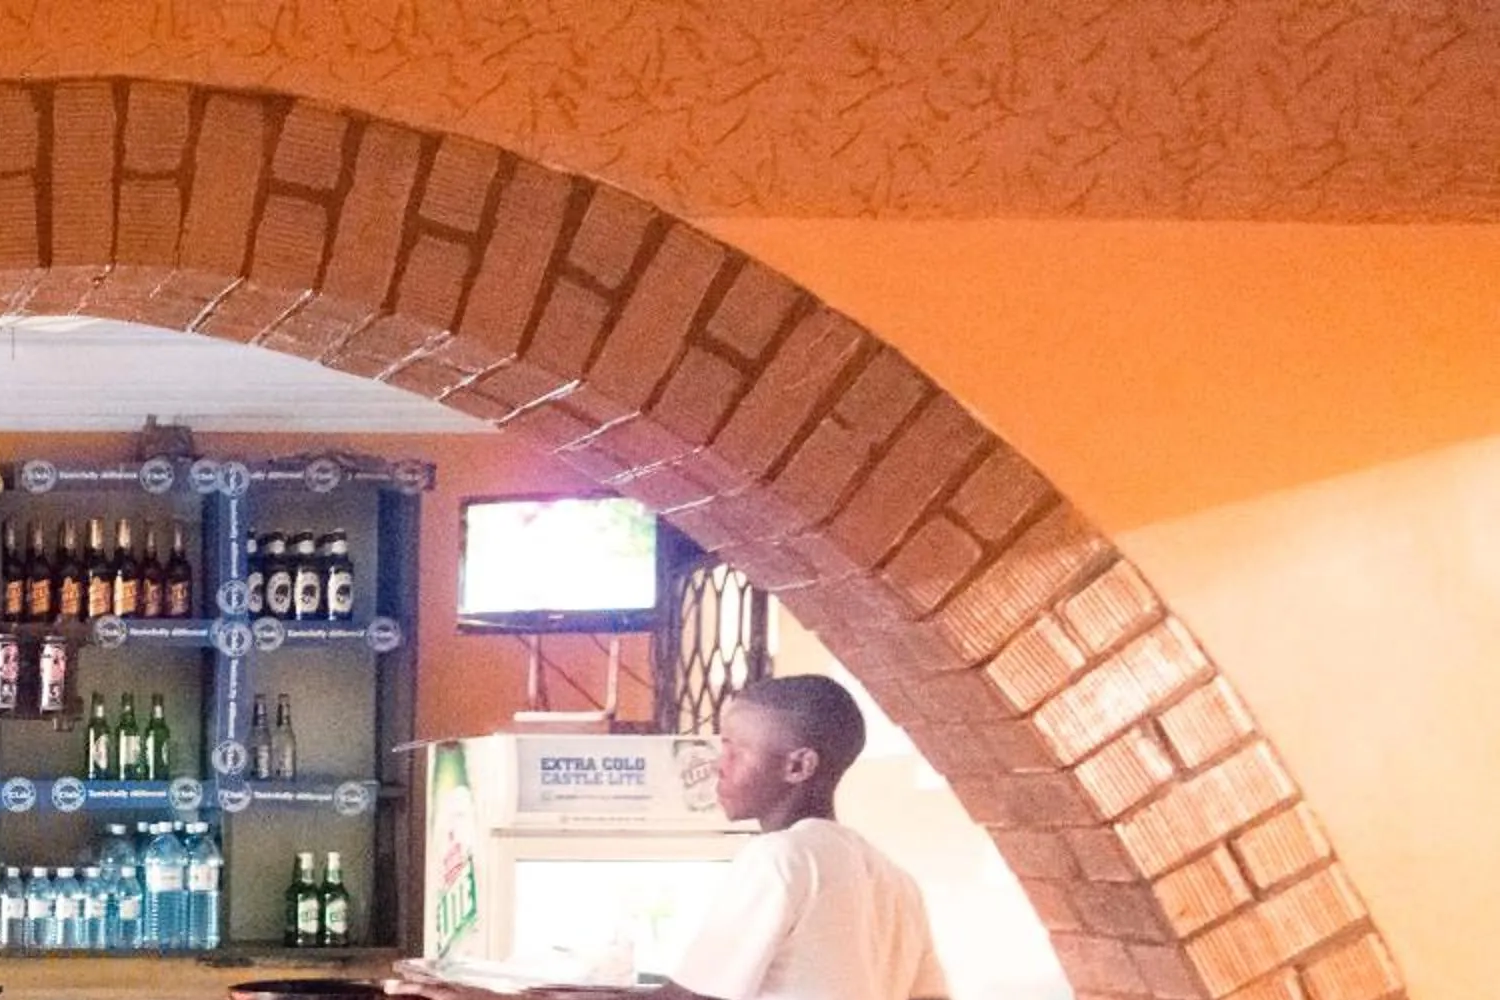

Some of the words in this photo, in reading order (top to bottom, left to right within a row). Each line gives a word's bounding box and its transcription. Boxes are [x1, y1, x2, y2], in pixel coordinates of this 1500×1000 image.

[541, 757, 596, 771] EXTRA
[602, 757, 646, 771] COLD
[541, 772, 603, 786] CASTLE
[608, 773, 646, 786] LITE
